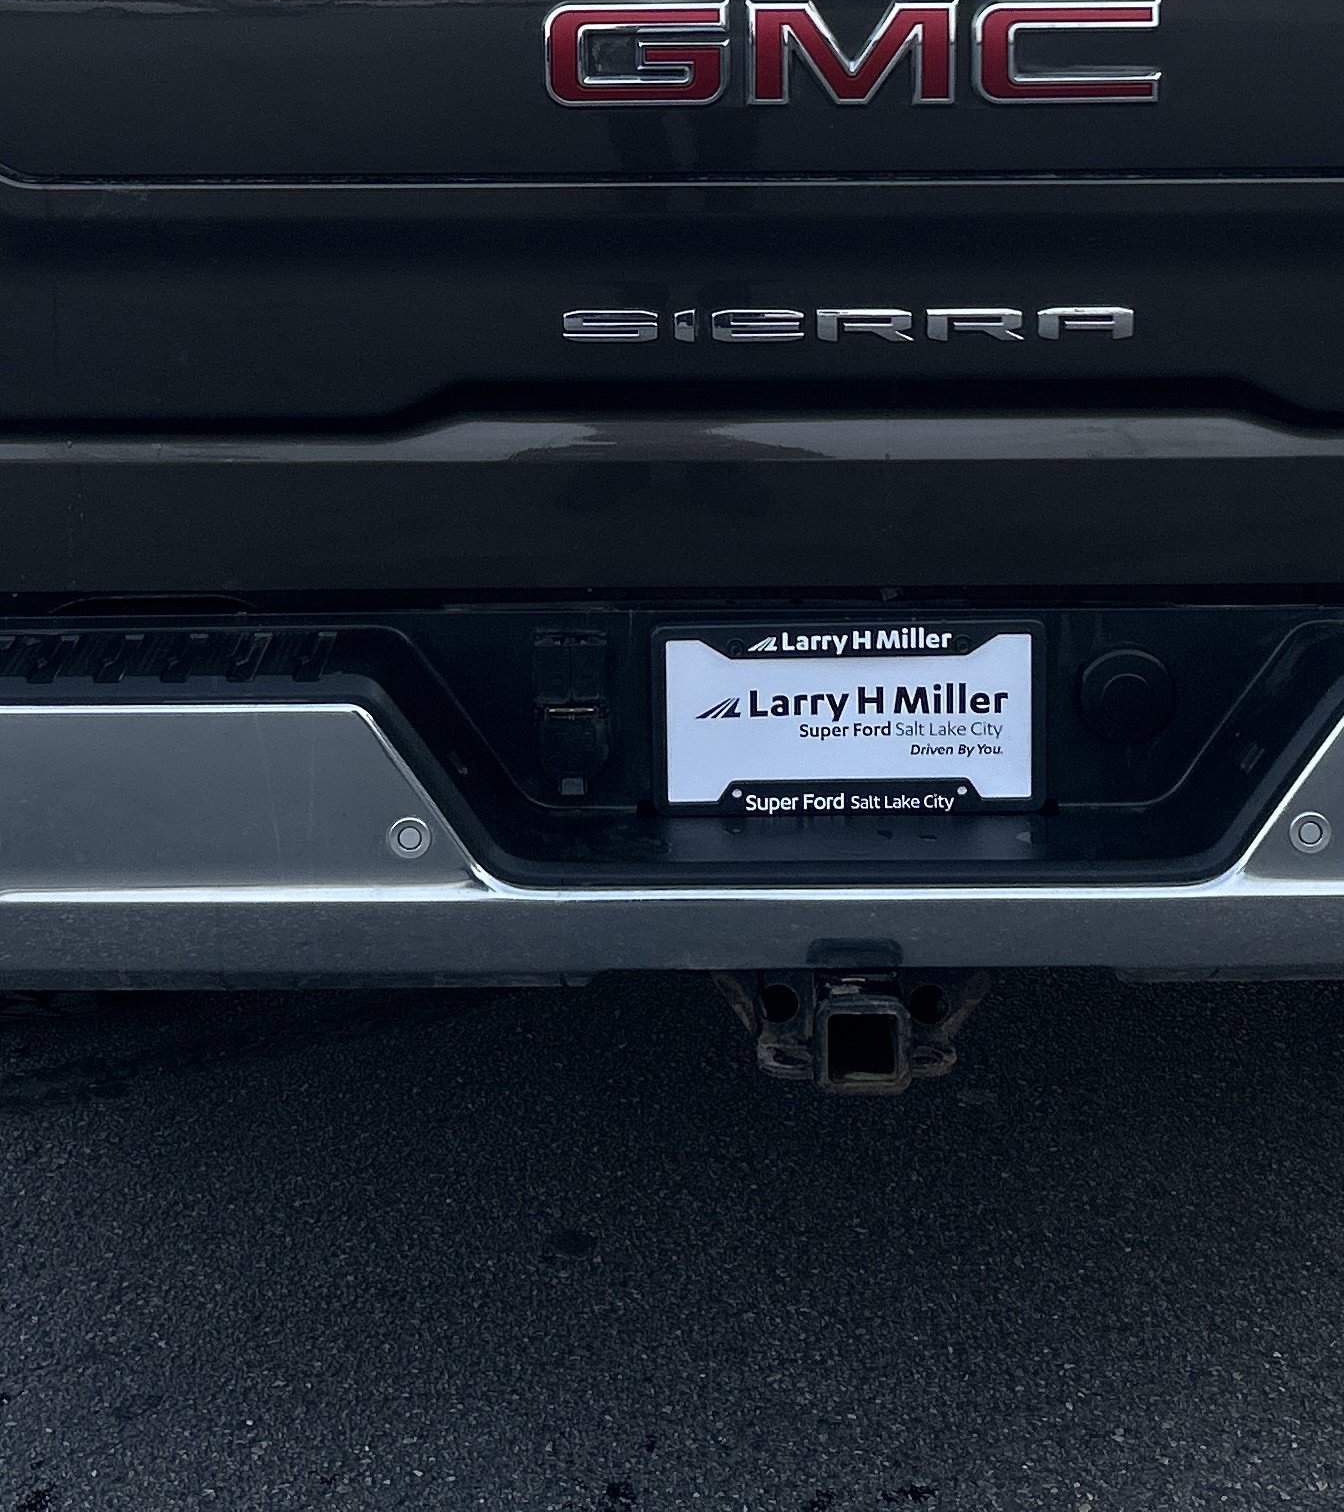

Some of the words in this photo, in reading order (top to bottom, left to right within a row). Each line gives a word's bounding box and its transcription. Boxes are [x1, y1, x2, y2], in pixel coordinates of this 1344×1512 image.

[562, 306, 1135, 343] SIERRA
[781, 631, 849, 656] Larry
[852, 630, 871, 650] H
[876, 626, 952, 650] Miller
[749, 690, 850, 722] Larry
[857, 686, 884, 714] H
[893, 682, 1009, 714] Miller
[799, 723, 849, 742] Super
[853, 721, 892, 737] Ford
[895, 721, 925, 737] Salt
[928, 720, 967, 736] Lake
[970, 720, 1003, 739] City
[910, 744, 954, 756] Driven
[957, 744, 975, 758] By
[745, 794, 799, 815] Super
[803, 792, 845, 810] Ford
[850, 795, 881, 809] Salt
[884, 794, 920, 809] Lake
[923, 793, 955, 812] City
